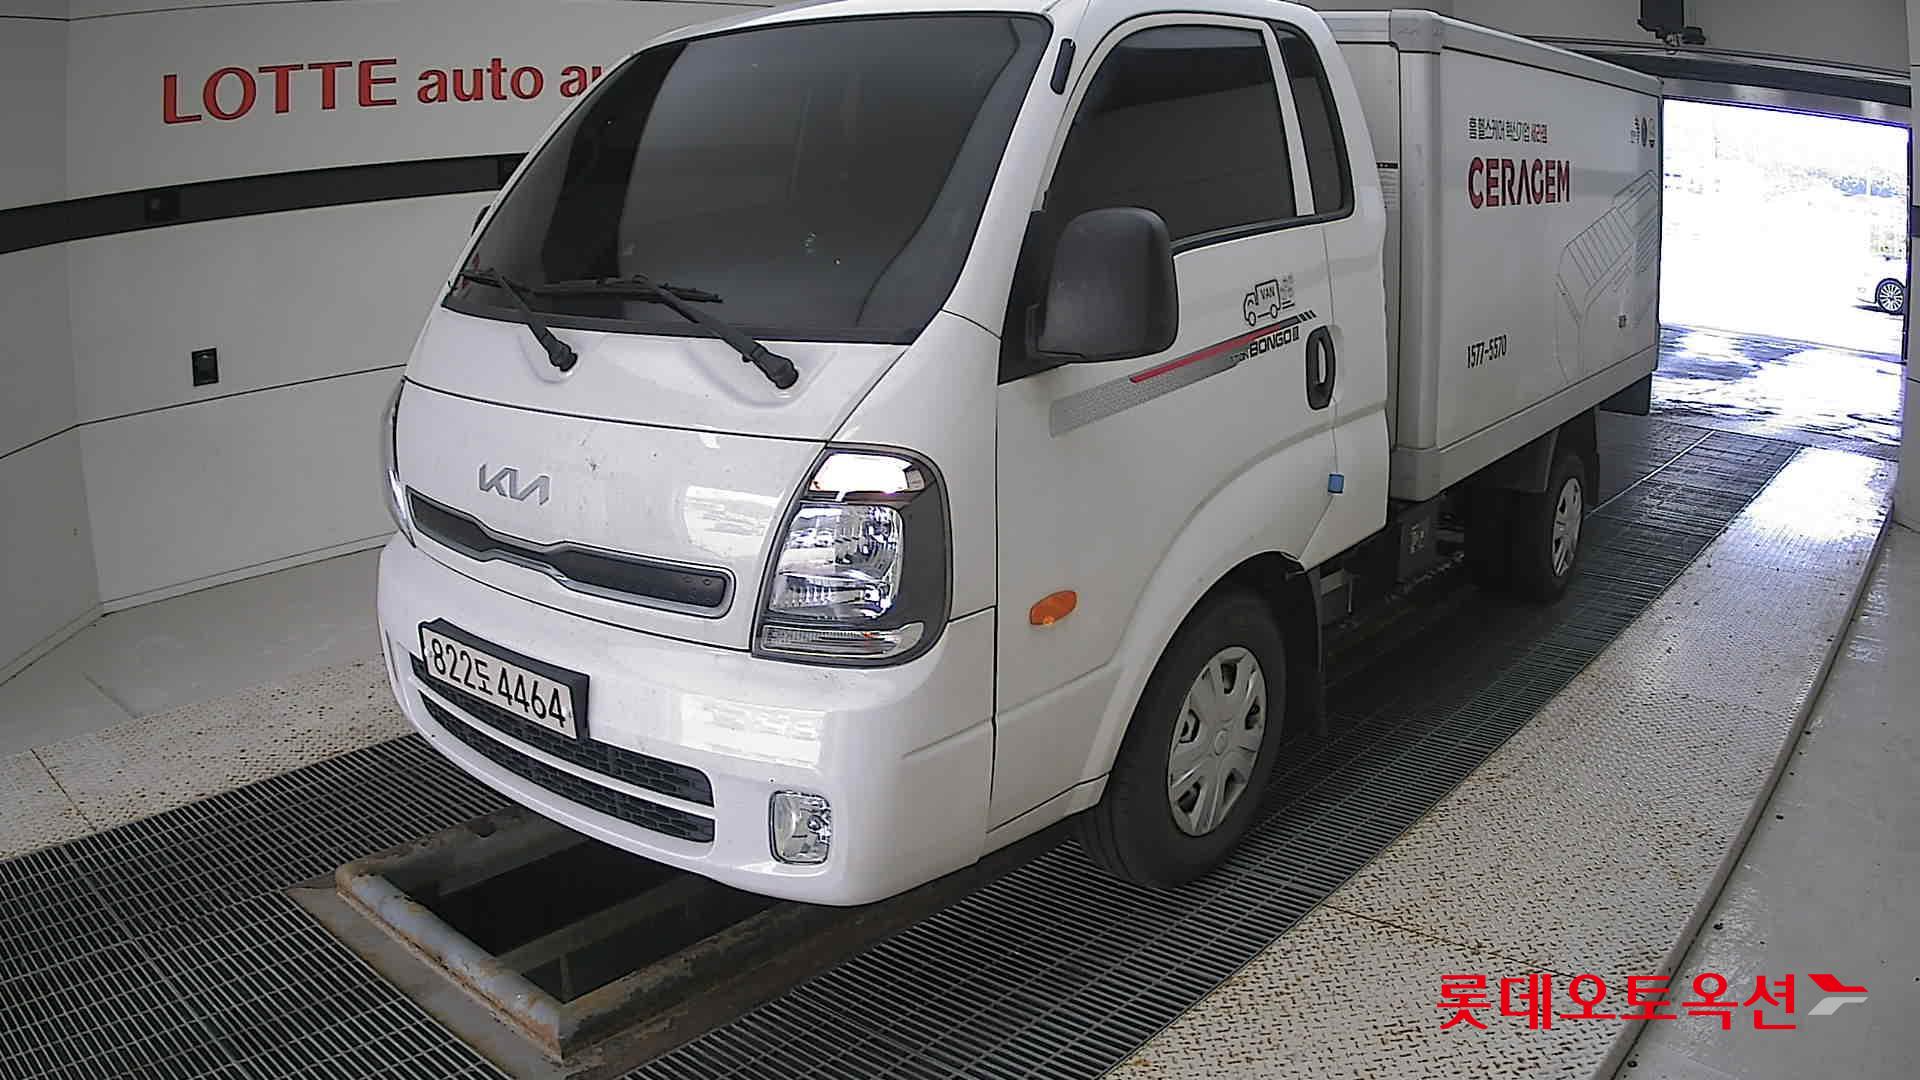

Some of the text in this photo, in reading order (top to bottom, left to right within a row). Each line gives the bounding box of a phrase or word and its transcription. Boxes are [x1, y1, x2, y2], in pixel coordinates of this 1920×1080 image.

[163, 58, 397, 125] LOTTE
[416, 57, 544, 104] auto
[1468, 157, 1570, 209] CERAGEM
[1260, 286, 1276, 300] VAN
[1249, 328, 1292, 358] BONGO
[1466, 334, 1508, 369] 1577-5570
[479, 463, 551, 506] KIA
[497, 667, 566, 729] 4464
